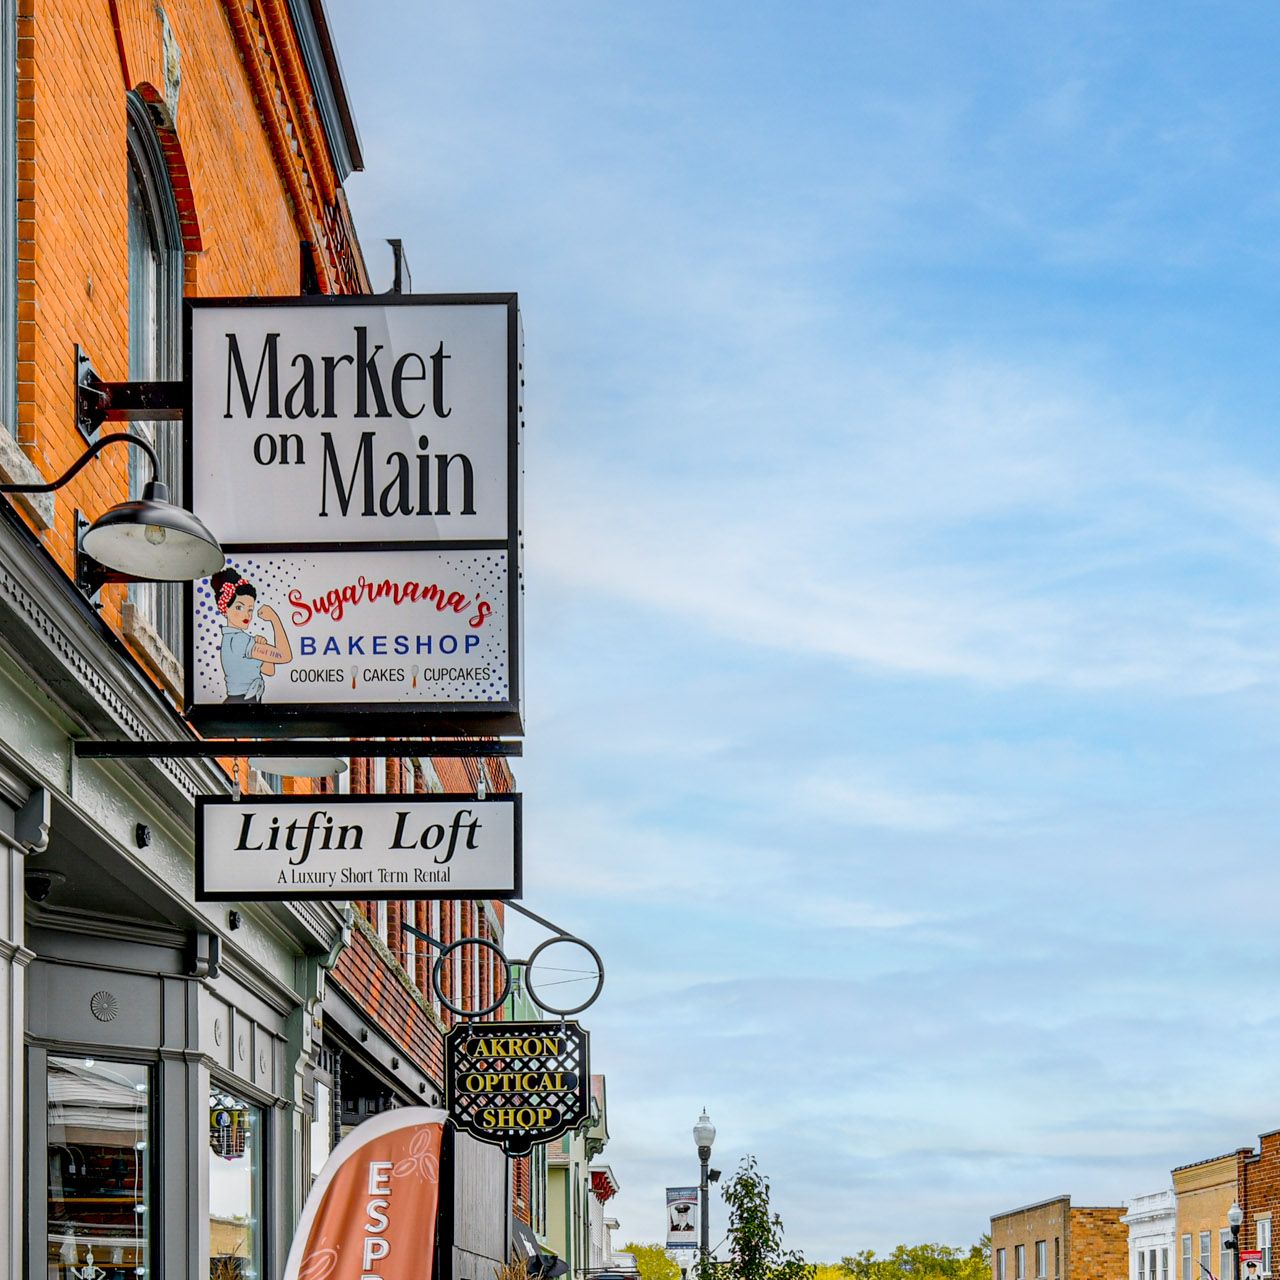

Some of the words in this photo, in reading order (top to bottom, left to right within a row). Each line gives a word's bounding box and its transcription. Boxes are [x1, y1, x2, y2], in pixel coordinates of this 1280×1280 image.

[223, 326, 452, 419] Market
[253, 432, 305, 465] on
[319, 432, 476, 517] Main
[289, 576, 494, 628] Sugarmama's
[300, 635, 481, 656] BAKESHOP
[290, 669, 344, 683] COOKIES
[363, 668, 405, 682] CAKES
[423, 668, 490, 682] CUPCAKES
[234, 811, 364, 866] Litfin
[389, 809, 482, 864] Loft
[277, 869, 287, 883] A
[291, 869, 336, 887] Luxury
[341, 868, 373, 883] Short
[378, 868, 408, 883] Term
[414, 867, 451, 883] Rental
[474, 1038, 560, 1057] AKRON
[466, 1073, 567, 1092] OPTICAL
[483, 1108, 552, 1129] SHOP
